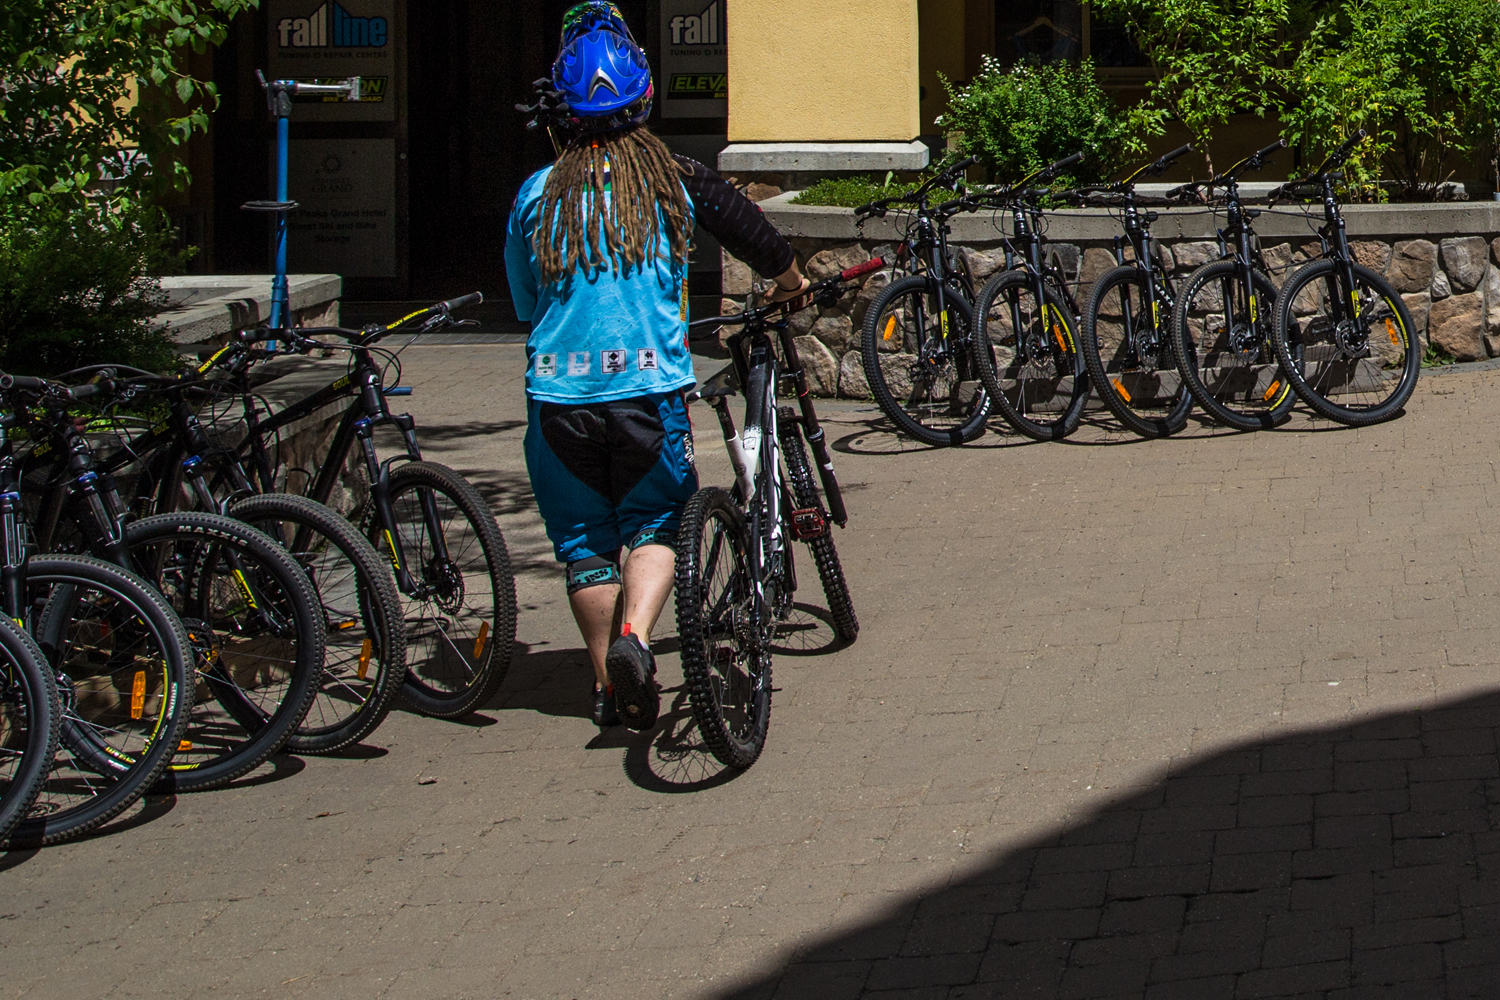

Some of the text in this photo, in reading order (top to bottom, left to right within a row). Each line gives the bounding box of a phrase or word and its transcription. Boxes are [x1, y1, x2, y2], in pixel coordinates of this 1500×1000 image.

[278, 0, 388, 47] fall line
[675, 76, 727, 92] ELEVA
[332, 377, 351, 391] SOUL
[152, 420, 171, 436] SOUL
[33, 441, 53, 458] SOUL
[176, 524, 249, 547] MAXXIS
